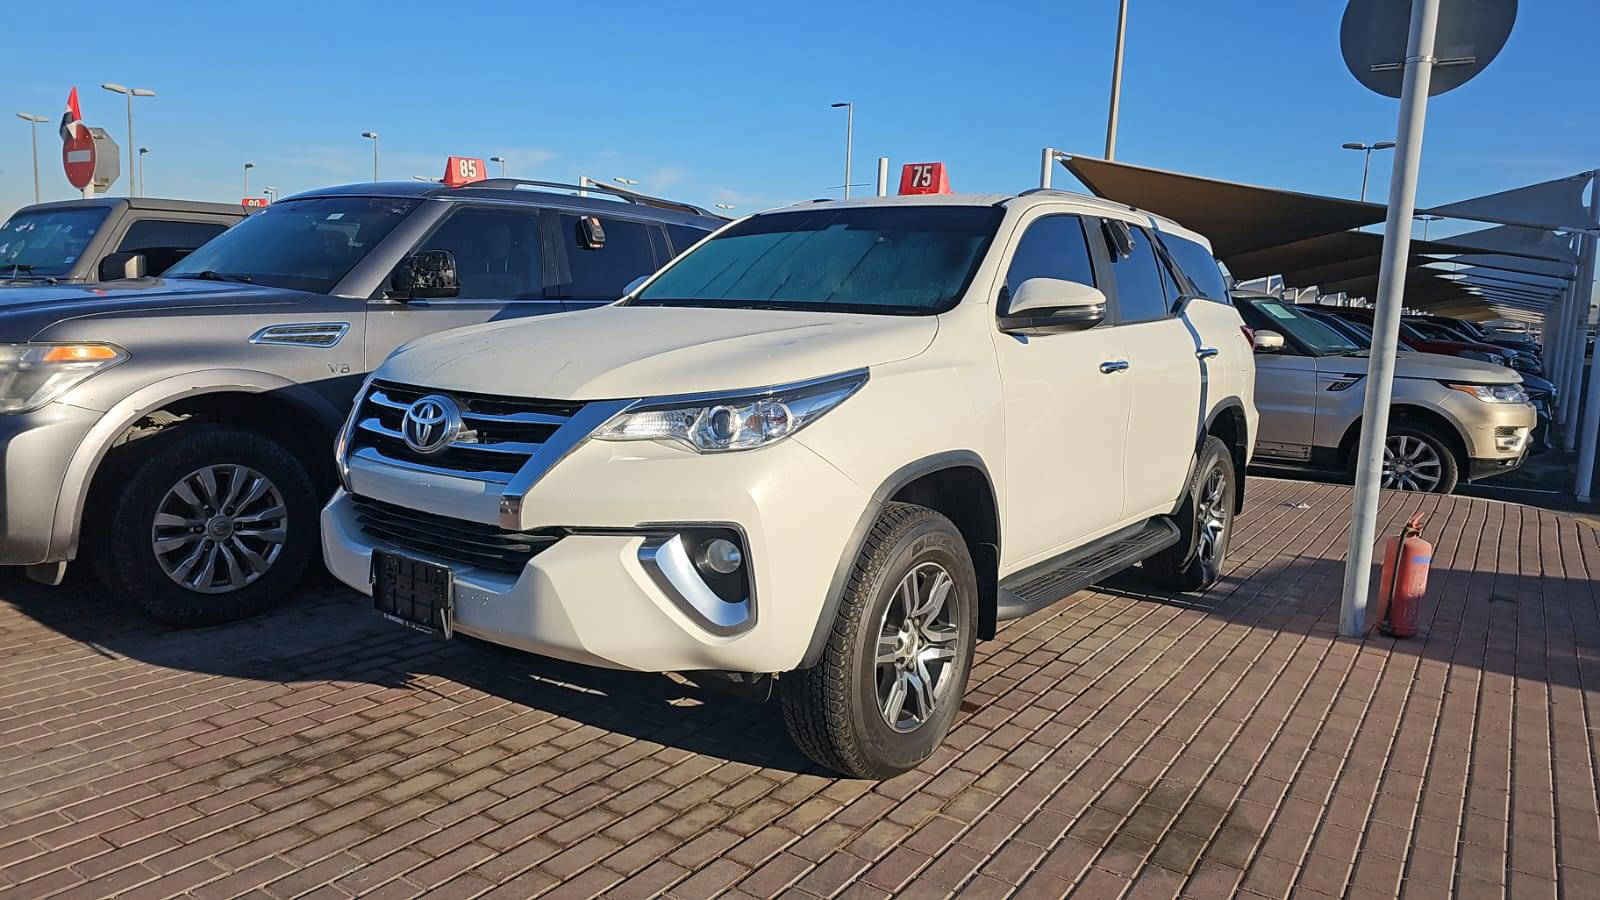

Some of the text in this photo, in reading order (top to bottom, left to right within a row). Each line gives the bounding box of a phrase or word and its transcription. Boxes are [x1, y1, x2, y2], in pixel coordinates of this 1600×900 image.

[460, 159, 477, 177] 85
[912, 165, 932, 187] 75
[327, 362, 351, 374] V8
